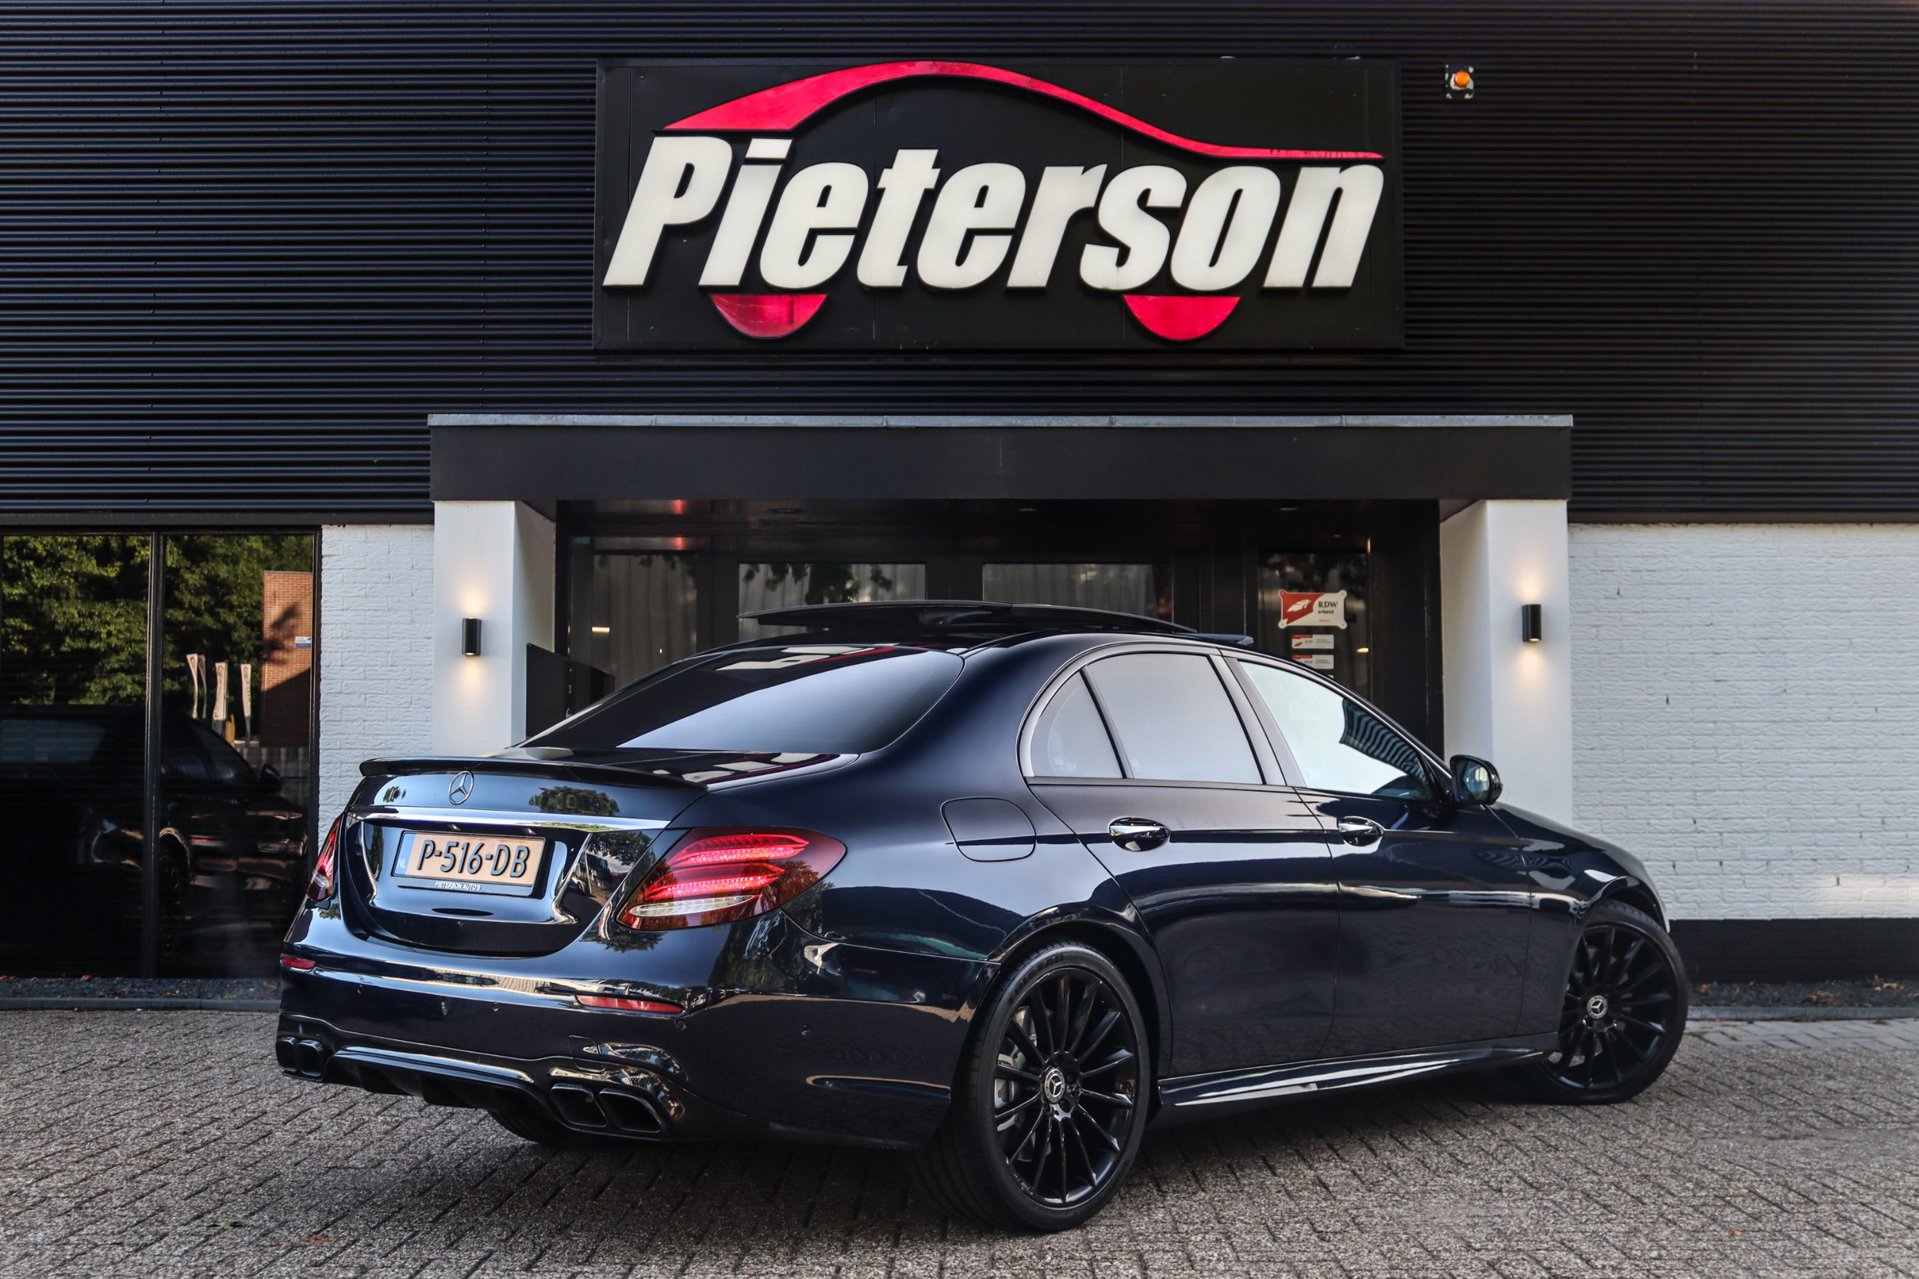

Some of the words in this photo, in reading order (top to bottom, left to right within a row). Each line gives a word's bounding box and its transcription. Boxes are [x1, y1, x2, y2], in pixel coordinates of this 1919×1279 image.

[602, 136, 1385, 291] Pieterson
[416, 839, 530, 878] P-516-DB
[434, 880, 461, 890] PIETERSON
